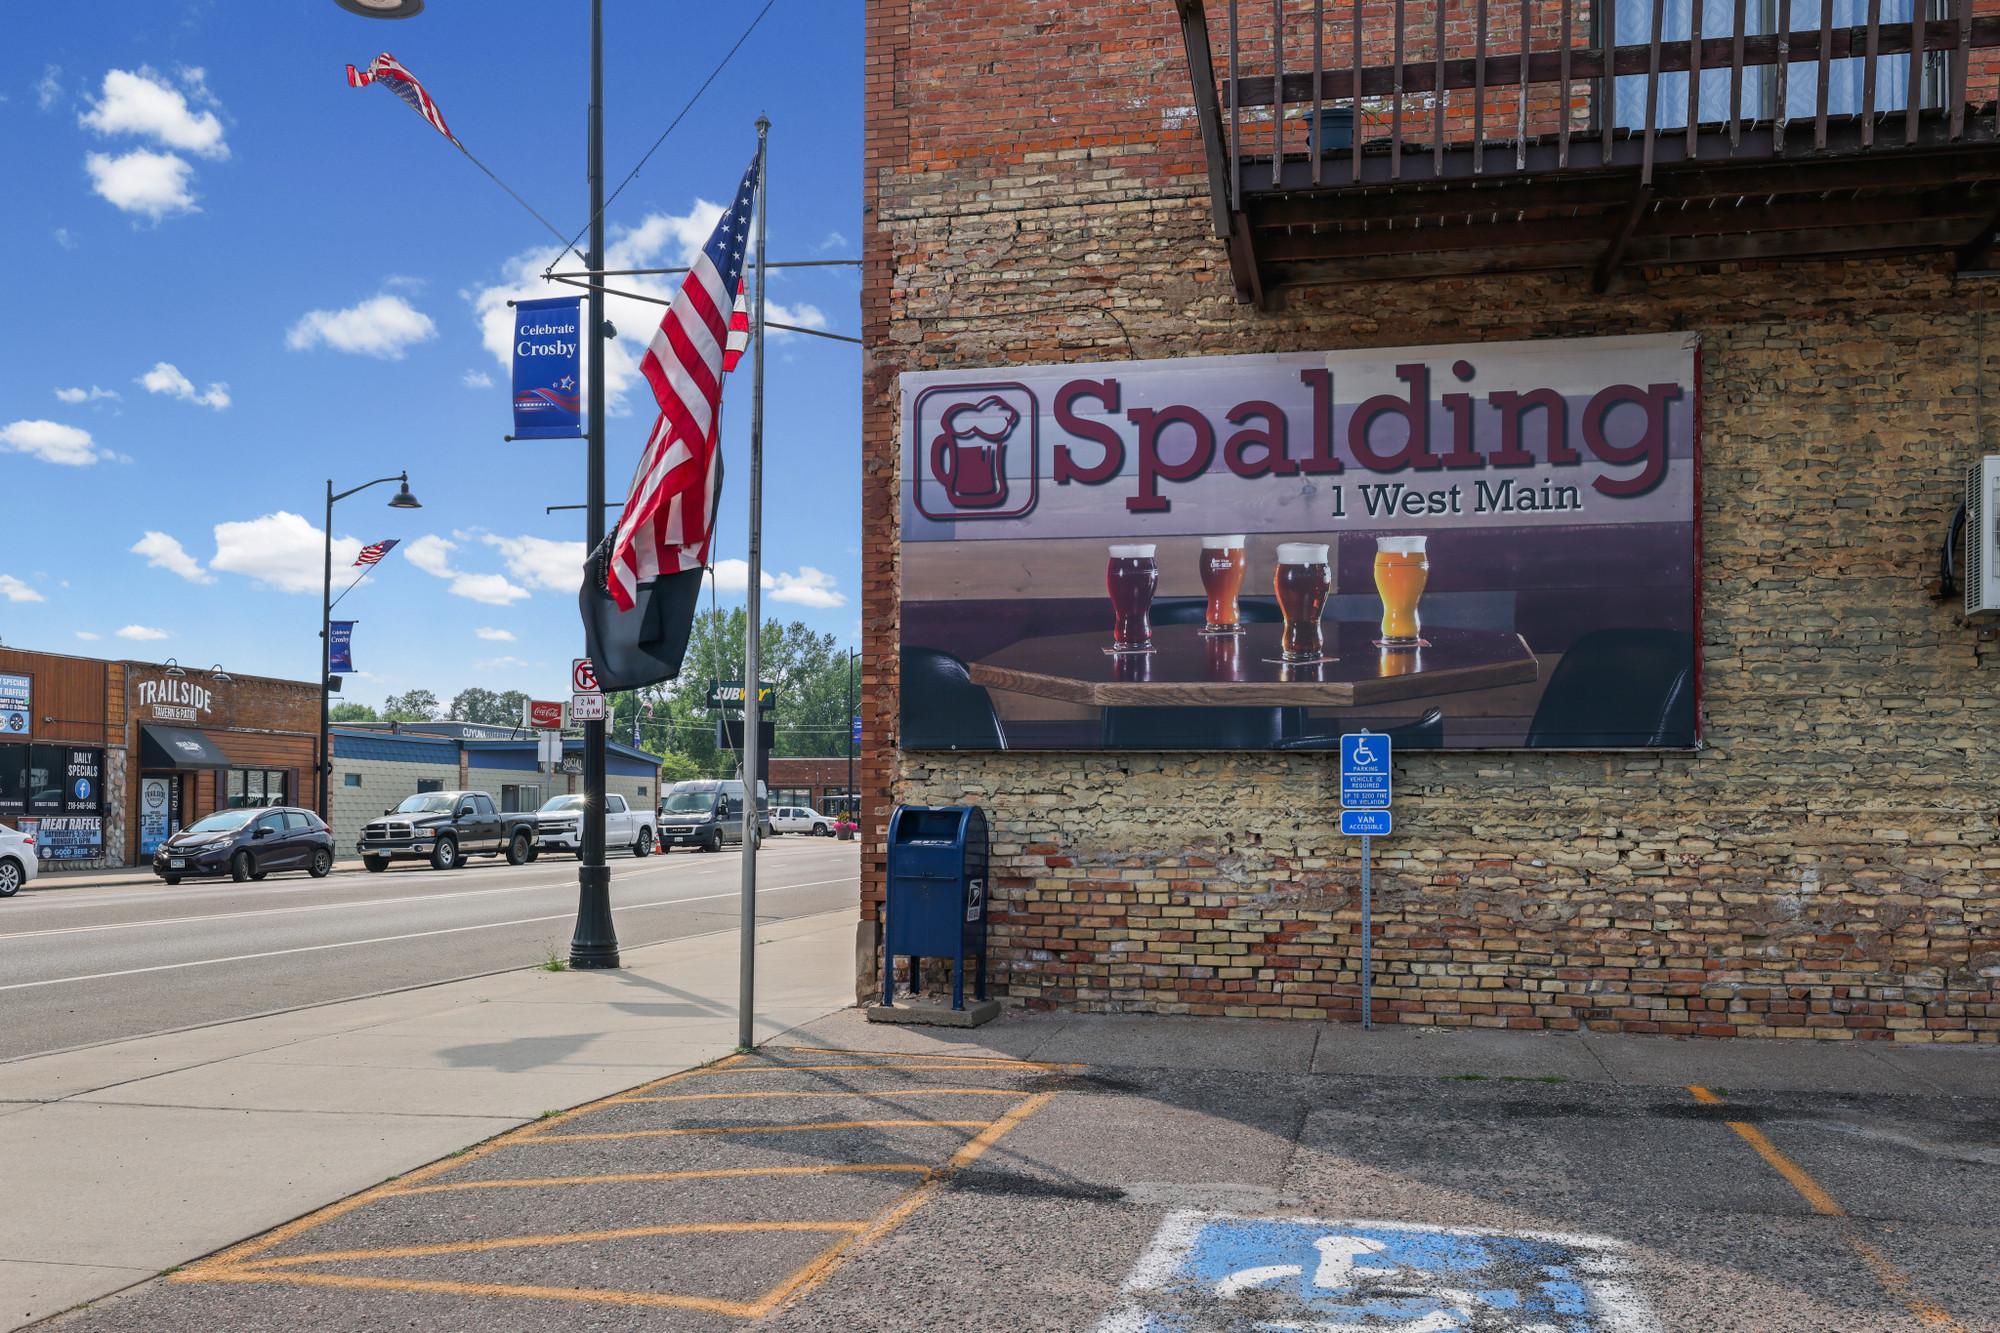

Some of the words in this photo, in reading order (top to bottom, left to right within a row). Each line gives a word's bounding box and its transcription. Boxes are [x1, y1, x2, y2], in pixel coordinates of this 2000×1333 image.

[520, 324, 575, 336] Celebrate
[517, 340, 577, 359] Crosby
[1052, 359, 1683, 514] Spalding
[1358, 483, 1463, 518] West
[1474, 478, 1584, 514] Main
[138, 679, 212, 713] TRAILSIDE
[712, 686, 771, 702] SUBWY
[155, 706, 175, 718] TAVERN
[176, 709, 180, 718] &
[181, 709, 194, 720] PATIO
[73, 752, 92, 764] DAILY
[563, 757, 583, 770] SOCIAL
[68, 765, 98, 777] SPECIALS
[41, 818, 68, 830] MEAT
[69, 818, 101, 830] RAFFLE
[1357, 815, 1375, 823] VAN
[45, 830, 75, 838] SATURDAYS
[52, 837, 77, 845] MONDAYS
[54, 848, 72, 856] GOOD
